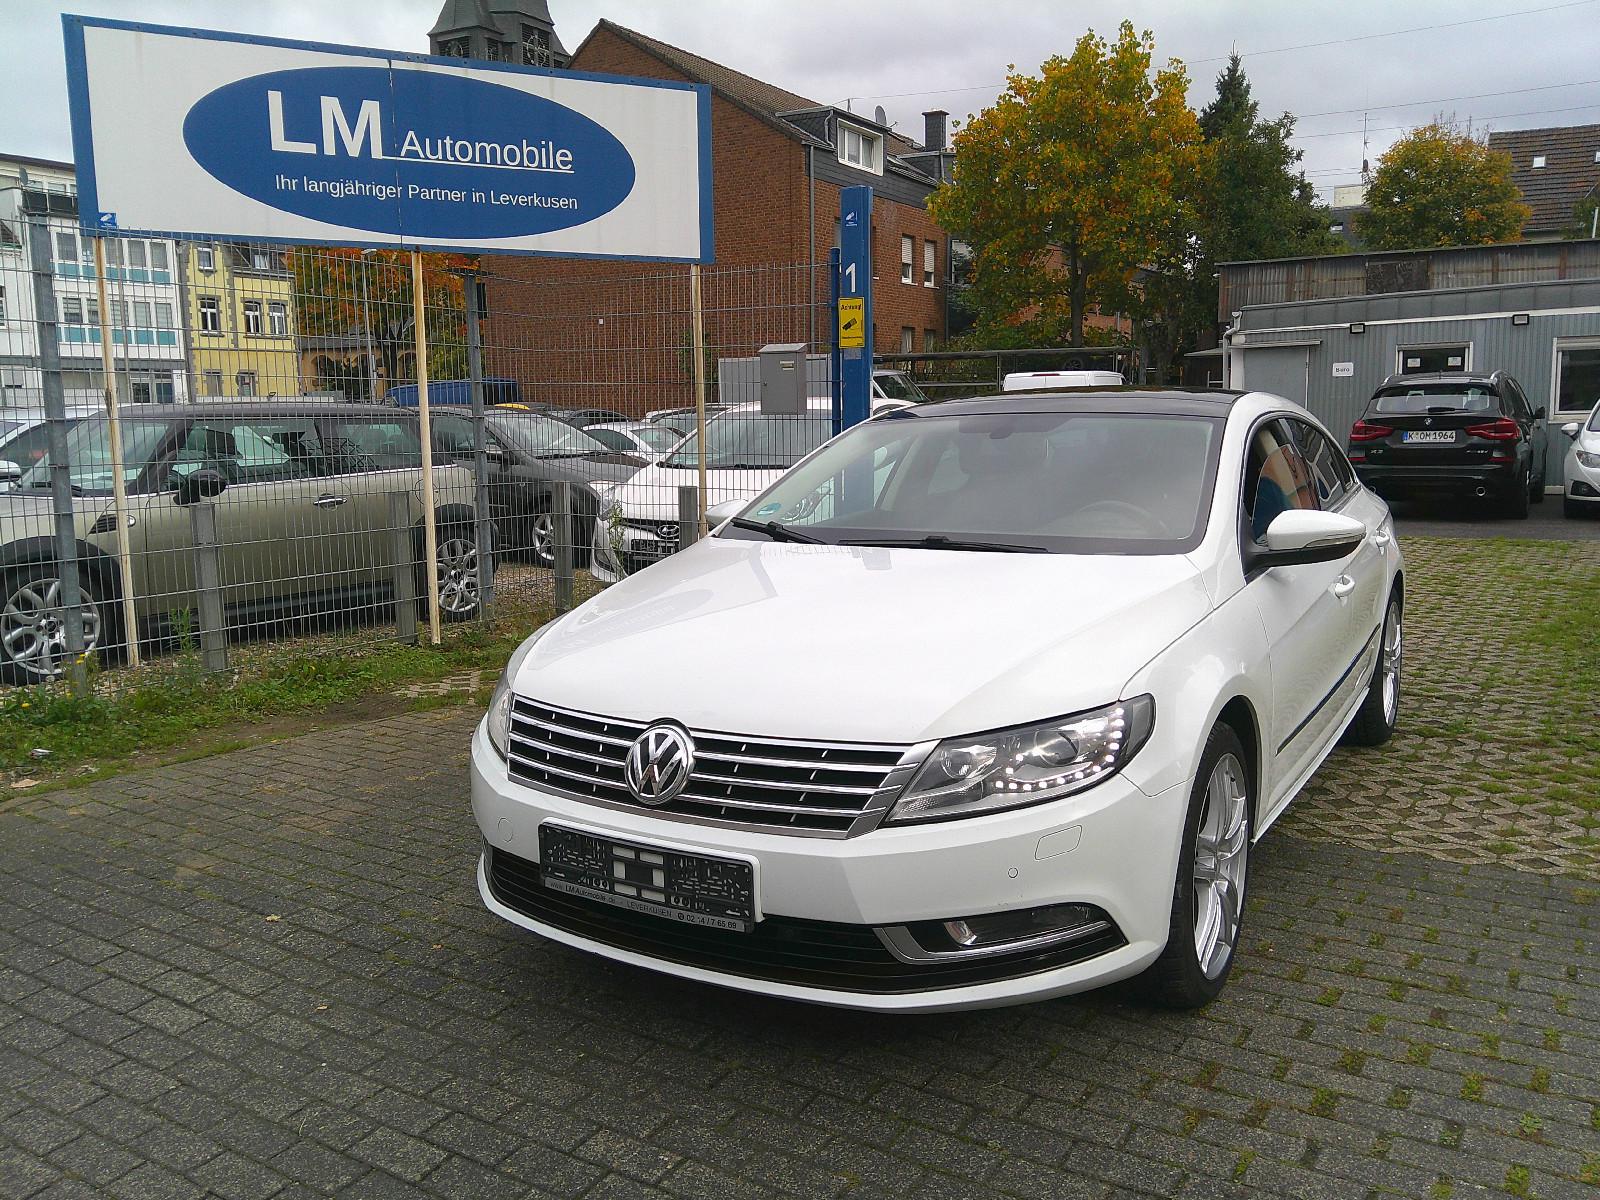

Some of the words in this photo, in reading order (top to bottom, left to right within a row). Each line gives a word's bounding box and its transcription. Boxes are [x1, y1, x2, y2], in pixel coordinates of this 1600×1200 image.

[268, 90, 383, 159] LM
[400, 130, 573, 170] Automobile
[276, 174, 298, 191] Ihr
[303, 175, 403, 200] langjähriger
[408, 184, 466, 202] Partner
[472, 188, 485, 203] in
[490, 190, 578, 210] Leverkusen
[845, 262, 856, 293] 1
